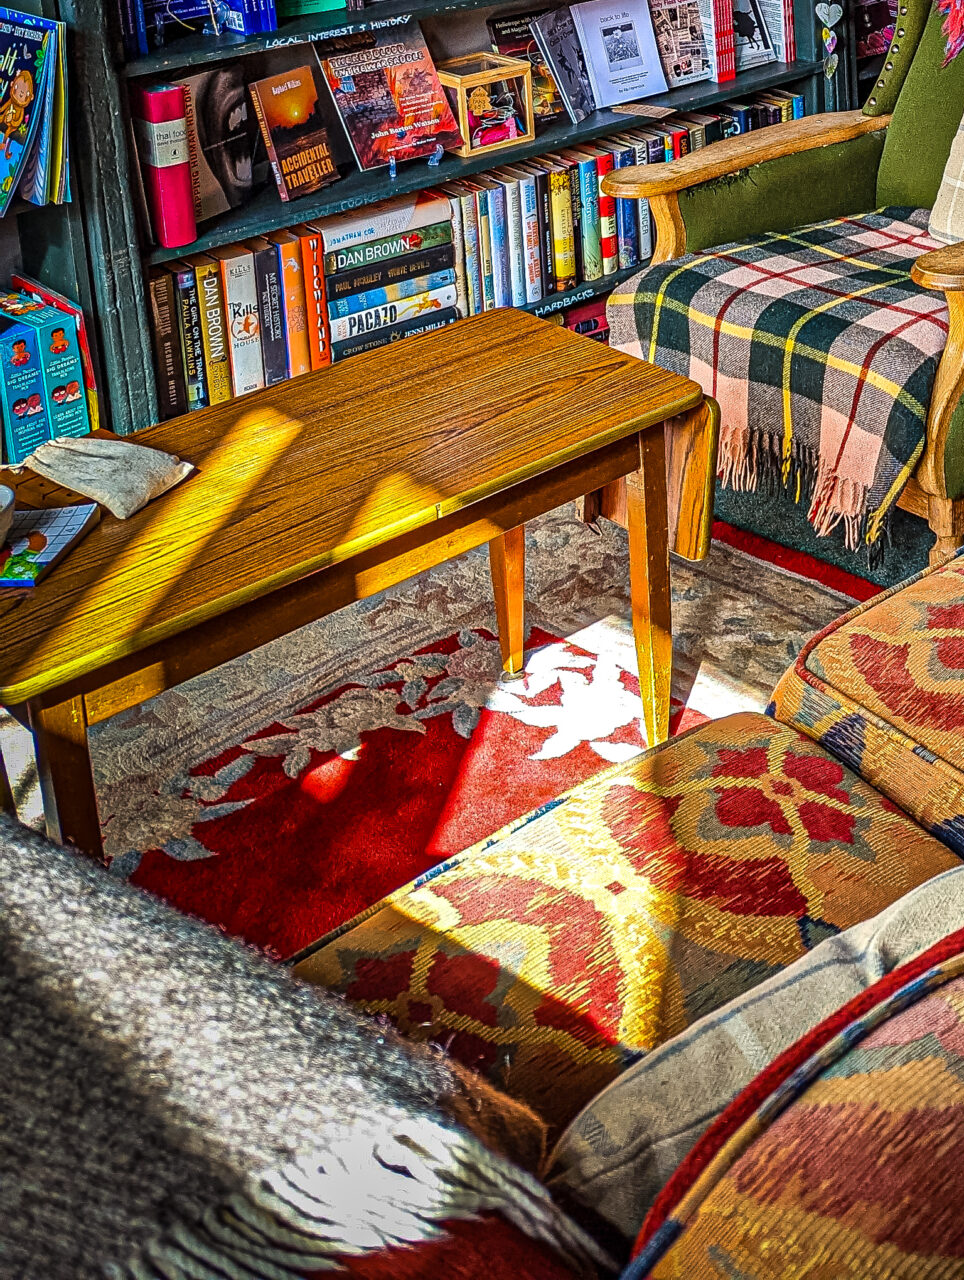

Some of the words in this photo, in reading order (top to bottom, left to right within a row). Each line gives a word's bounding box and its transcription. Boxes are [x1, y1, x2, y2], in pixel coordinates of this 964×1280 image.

[266, 37, 303, 49] LOCAL
[308, 26, 354, 41] INTEREST
[370, 14, 413, 31] HISTORY
[388, 51, 425, 67] SADDLE
[184, 83, 195, 128] HISTORY
[371, 128, 388, 139] John
[388, 123, 414, 135] Barton
[414, 118, 440, 131] Watson
[188, 130, 200, 170] HUMAN
[281, 143, 330, 174] ACCIDENTAL
[285, 159, 334, 190] TRAVELLER
[584, 172, 592, 195] Sweet
[585, 196, 593, 224] Sorrow
[640, 198, 649, 235] SILENCER
[329, 231, 362, 246] JONATHAN
[363, 227, 376, 236] COE
[337, 250, 363, 268] DAN
[365, 238, 410, 261] BROWN
[269, 272, 277, 283] MY
[409, 261, 430, 272] DEVILS
[188, 287, 197, 304] THE
[203, 277, 218, 307] DAN
[270, 284, 279, 308] SECRET
[308, 238, 326, 353] WIDOWLAND
[335, 283, 351, 293] PAUL
[182, 299, 191, 329] PAULA
[228, 302, 242, 311] The
[233, 304, 259, 318] Kills
[534, 288, 595, 318] HARDBACKS
[190, 306, 199, 326] GIRL
[272, 308, 283, 340] HISTORY
[348, 304, 398, 337] PACAZO
[192, 327, 200, 339] ON
[206, 308, 225, 359] BROWN
[404, 325, 424, 338] JENNI
[425, 320, 446, 332] MILLS
[184, 332, 196, 375] HAWKINS
[193, 340, 202, 355] THE
[233, 338, 260, 349] HOUSE
[343, 344, 363, 356] CROW
[364, 337, 387, 350] STONE
[194, 357, 204, 381] TRAIN
